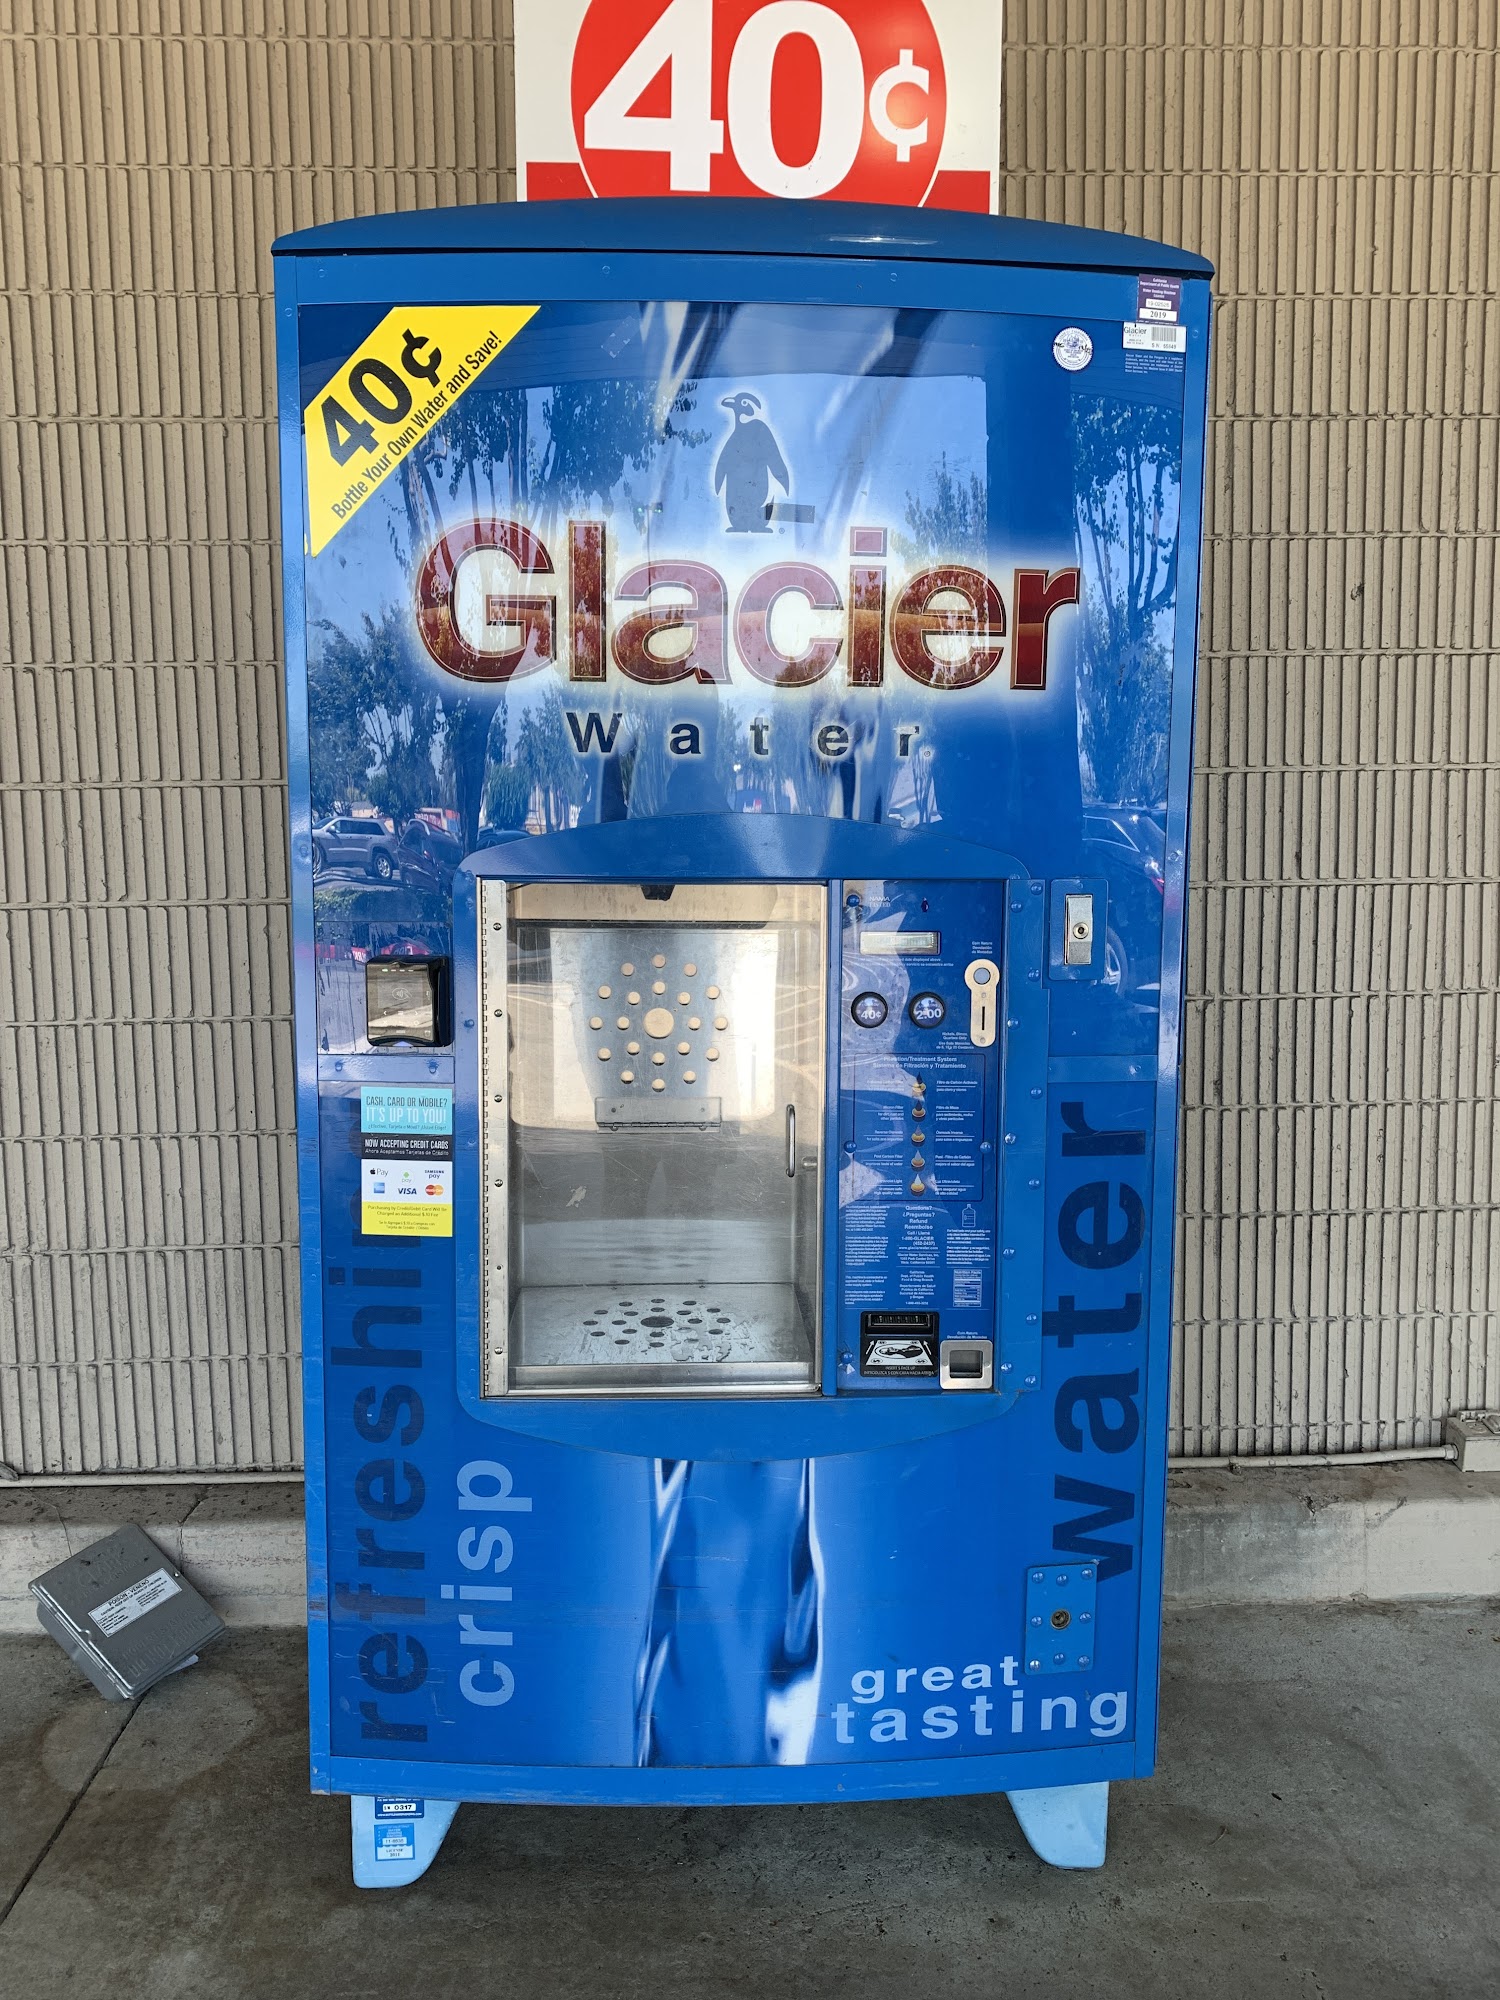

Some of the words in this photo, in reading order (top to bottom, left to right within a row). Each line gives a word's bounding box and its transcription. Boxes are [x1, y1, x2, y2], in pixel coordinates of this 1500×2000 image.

[584, 0, 930, 199] 40¢
[1124, 326, 1148, 334] Glacier
[321, 328, 442, 467] 40¢
[330, 479, 369, 519] Bottle
[361, 448, 393, 483] Your
[387, 426, 418, 456] Own
[410, 390, 449, 428] Water
[445, 364, 471, 395] and
[465, 330, 502, 371] Save!
[415, 517, 1081, 692] Glacier
[566, 711, 920, 757] Water
[861, 1010, 882, 1020] 40¢
[366, 1096, 386, 1106] CASH,
[387, 1096, 404, 1106] CARD
[407, 1096, 416, 1107] OR
[418, 1098, 448, 1108] MOBILE?
[366, 1106, 386, 1122] IT'S
[390, 1108, 404, 1122] UP
[407, 1108, 419, 1124] TO
[422, 1108, 447, 1124] YOU!
[365, 1138, 379, 1148] NOW
[380, 1139, 409, 1148] ACCEPTING
[410, 1140, 430, 1149] CREDIT
[430, 1140, 449, 1150] CARDS
[377, 1168, 388, 1177] Pay
[1041, 1100, 1147, 1583] water
[108, 1592, 128, 1606] POISON
[130, 1579, 149, 1594] VENENO
[440, 1459, 533, 1708] crisp
[851, 1655, 1020, 1705] great
[831, 1690, 1130, 1745] tasting
